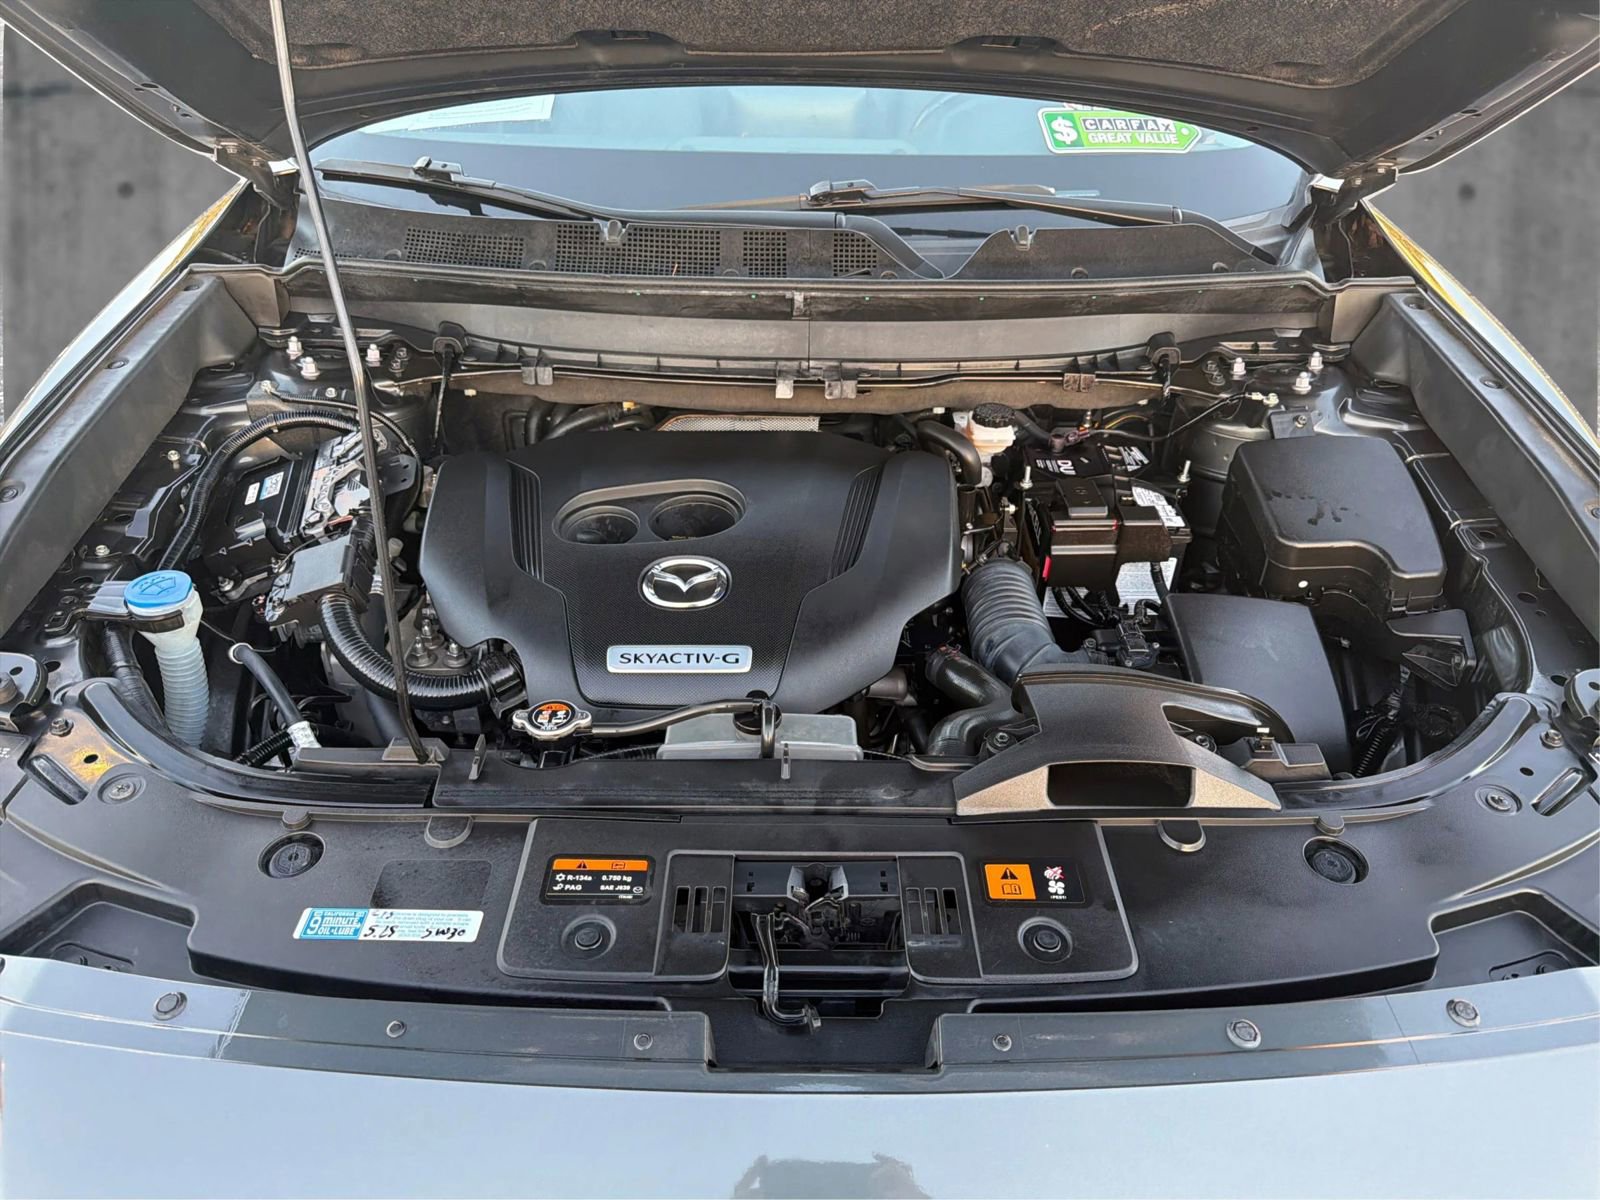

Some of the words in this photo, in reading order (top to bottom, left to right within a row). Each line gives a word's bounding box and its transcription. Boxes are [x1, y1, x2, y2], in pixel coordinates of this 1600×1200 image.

[1082, 117, 1175, 132] CARFAX
[1088, 132, 1132, 144] GREAT
[1135, 133, 1179, 145] VALUE
[618, 652, 740, 665] SKYACTIV-G
[306, 916, 322, 935] 9
